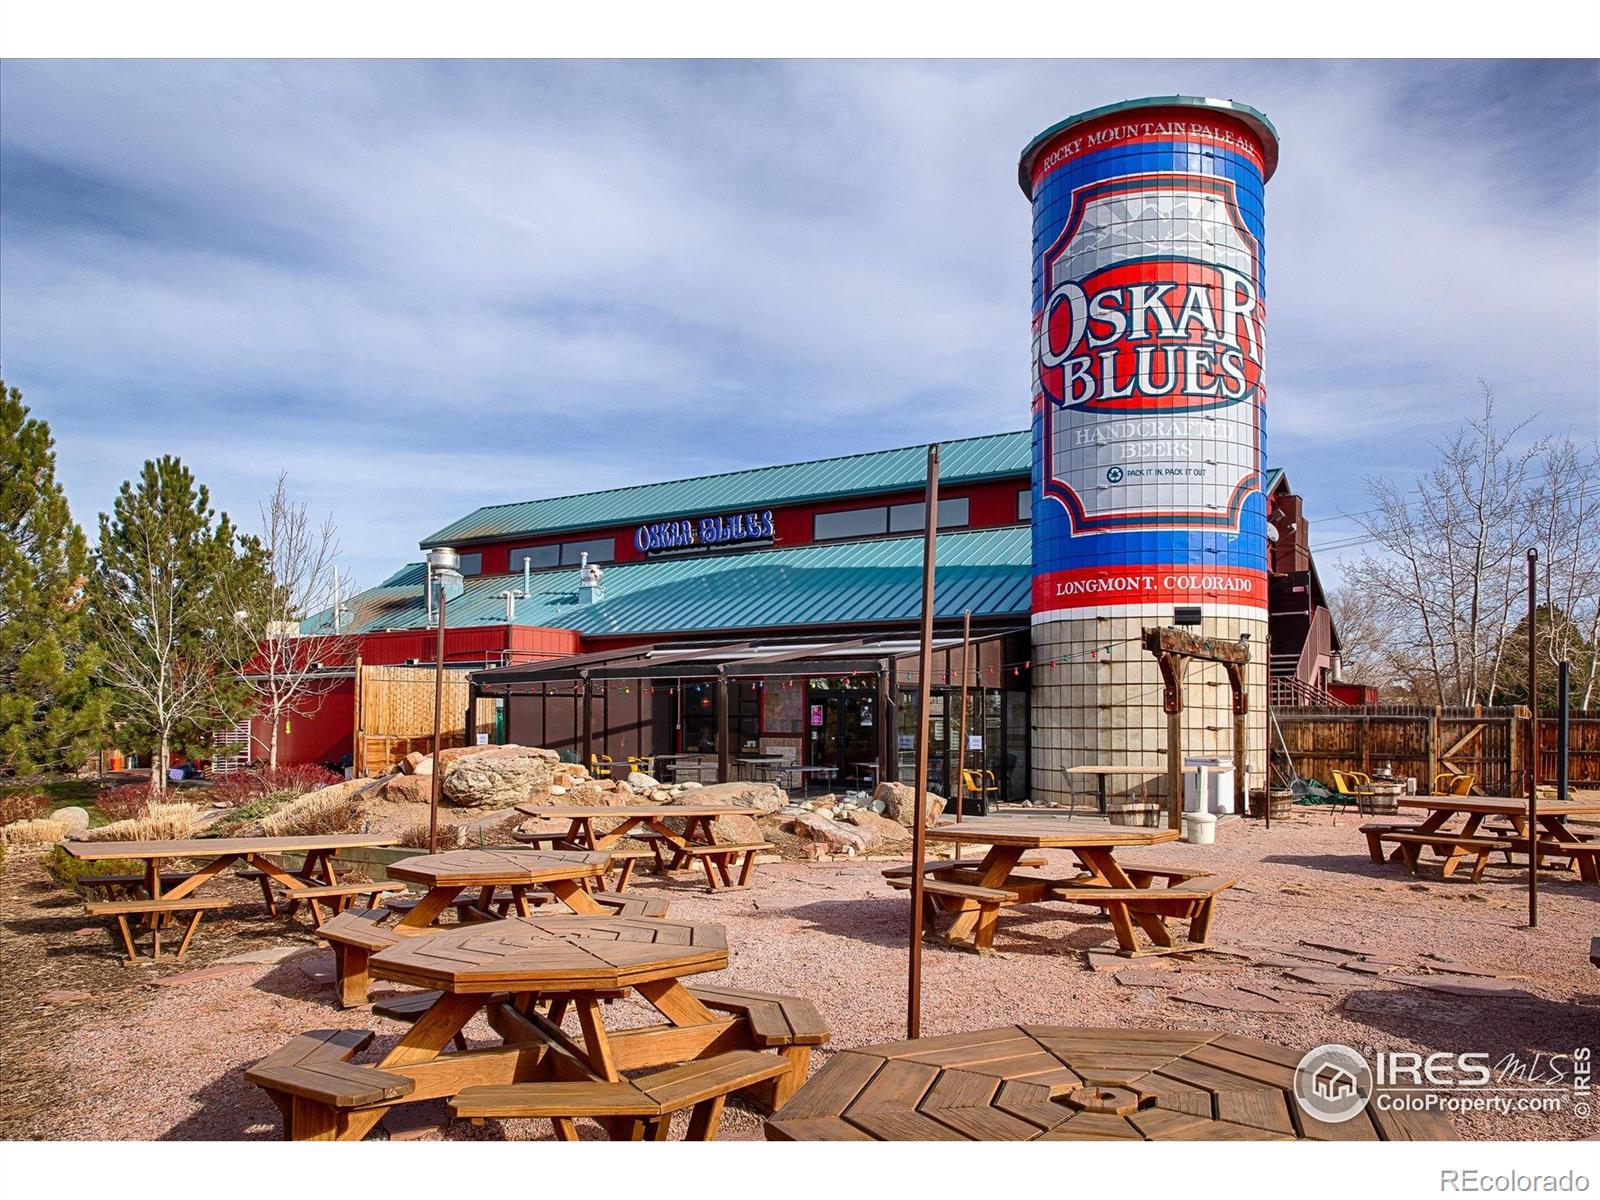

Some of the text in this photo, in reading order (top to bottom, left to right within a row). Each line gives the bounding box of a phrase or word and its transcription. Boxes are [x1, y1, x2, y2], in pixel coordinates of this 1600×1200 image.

[1042, 138, 1083, 171] ROCKY
[1087, 122, 1186, 148] MOUNTAIN
[1190, 123, 1236, 145] PALE
[1040, 265, 1260, 368] OSKAR
[1061, 345, 1247, 408] BLUES
[1075, 419, 1234, 445] HANDCRAFTED
[1119, 441, 1193, 459] BEERS
[1127, 469, 1144, 477] PACK
[1145, 468, 1153, 476] IT
[1165, 468, 1183, 477] PACK
[1185, 468, 1193, 476] IT
[1193, 468, 1206, 477] OUT
[634, 510, 774, 552] OSKAR BLUES
[1056, 575, 1252, 596] LONGMONT, COLORADO
